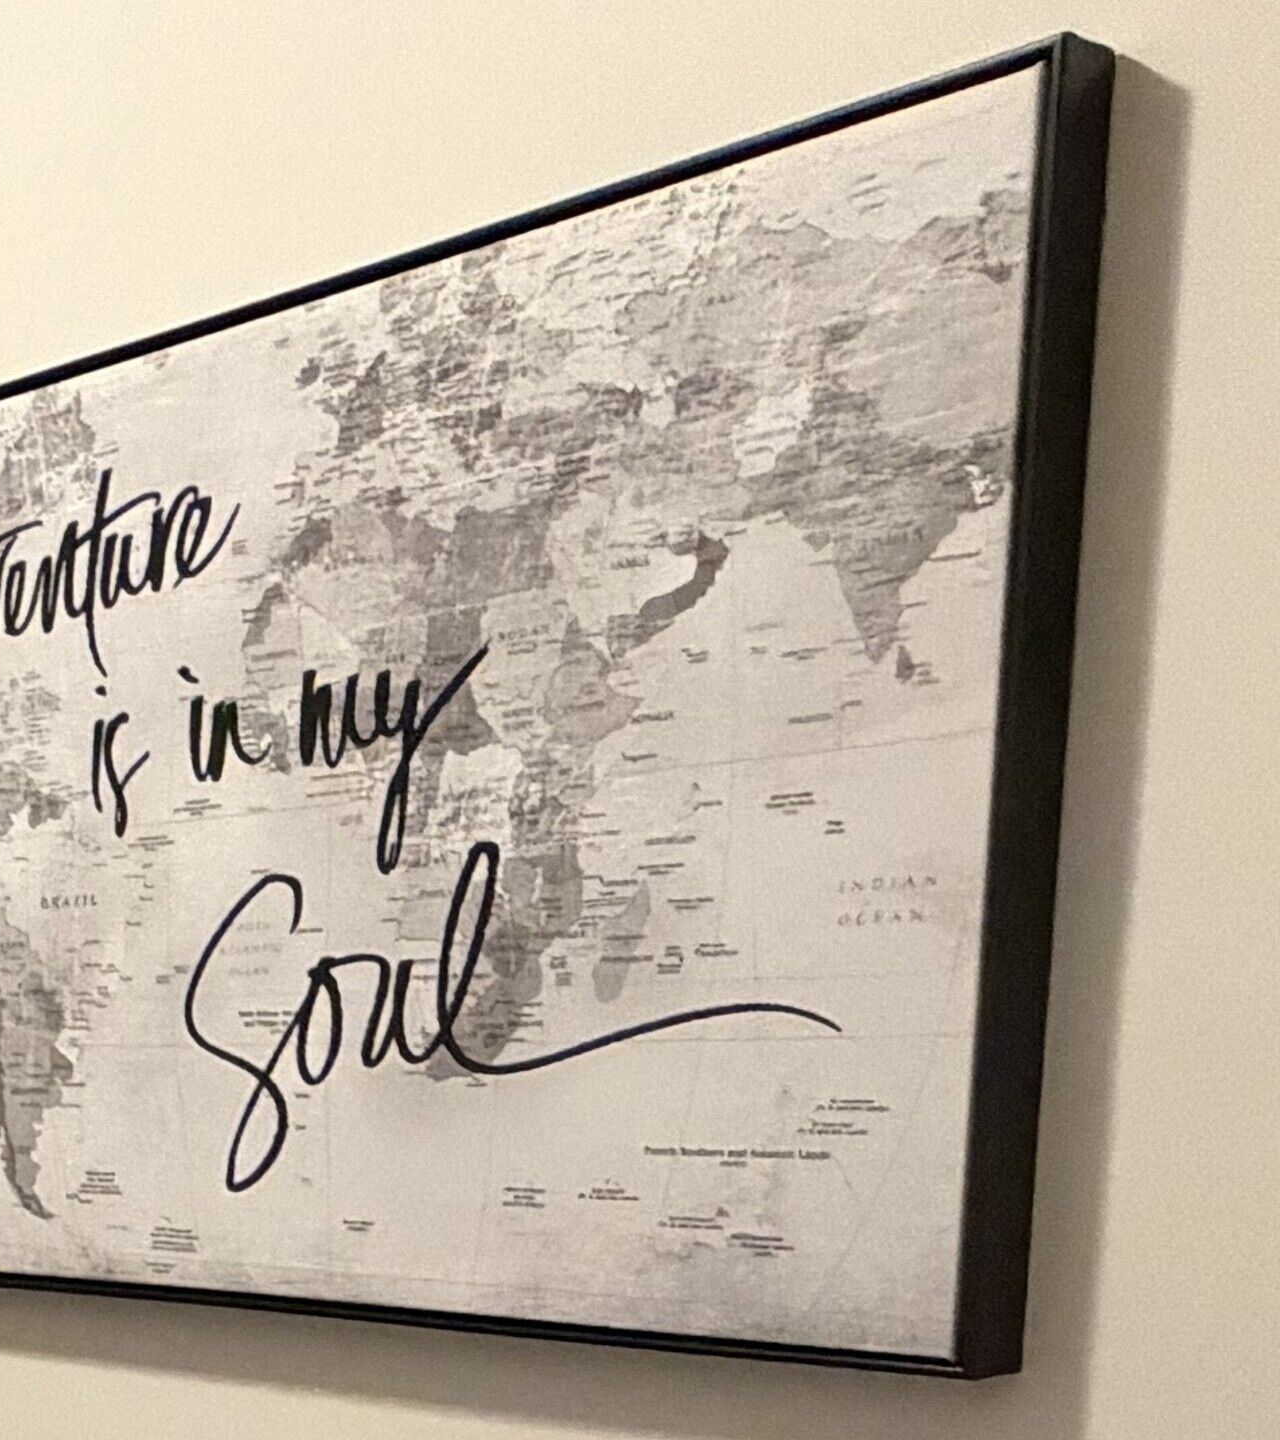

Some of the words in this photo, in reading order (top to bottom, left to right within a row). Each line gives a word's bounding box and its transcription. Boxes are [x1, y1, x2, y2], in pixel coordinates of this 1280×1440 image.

[91, 684, 150, 837] is
[177, 665, 271, 782] in
[298, 640, 491, 874] my
[184, 841, 843, 1192] Soul
